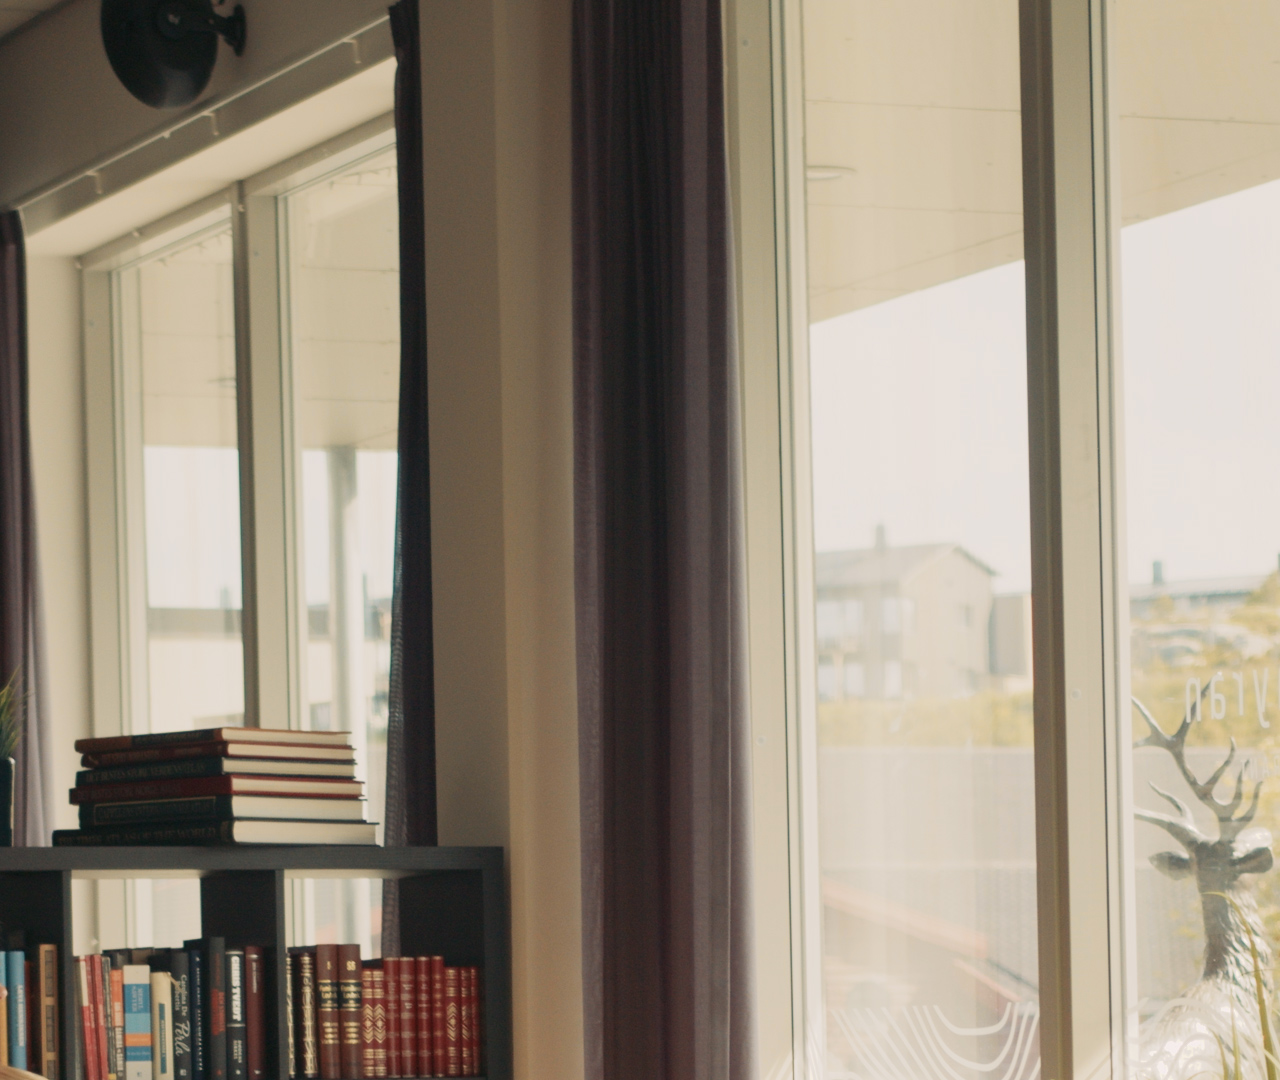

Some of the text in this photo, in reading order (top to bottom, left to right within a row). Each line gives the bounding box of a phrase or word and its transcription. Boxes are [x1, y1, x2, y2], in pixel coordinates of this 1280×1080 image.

[181, 974, 189, 1004] Carolina
[231, 956, 242, 1021] CHRIS TVEDT
[181, 1005, 189, 1017] De
[173, 1020, 192, 1057] Perla
